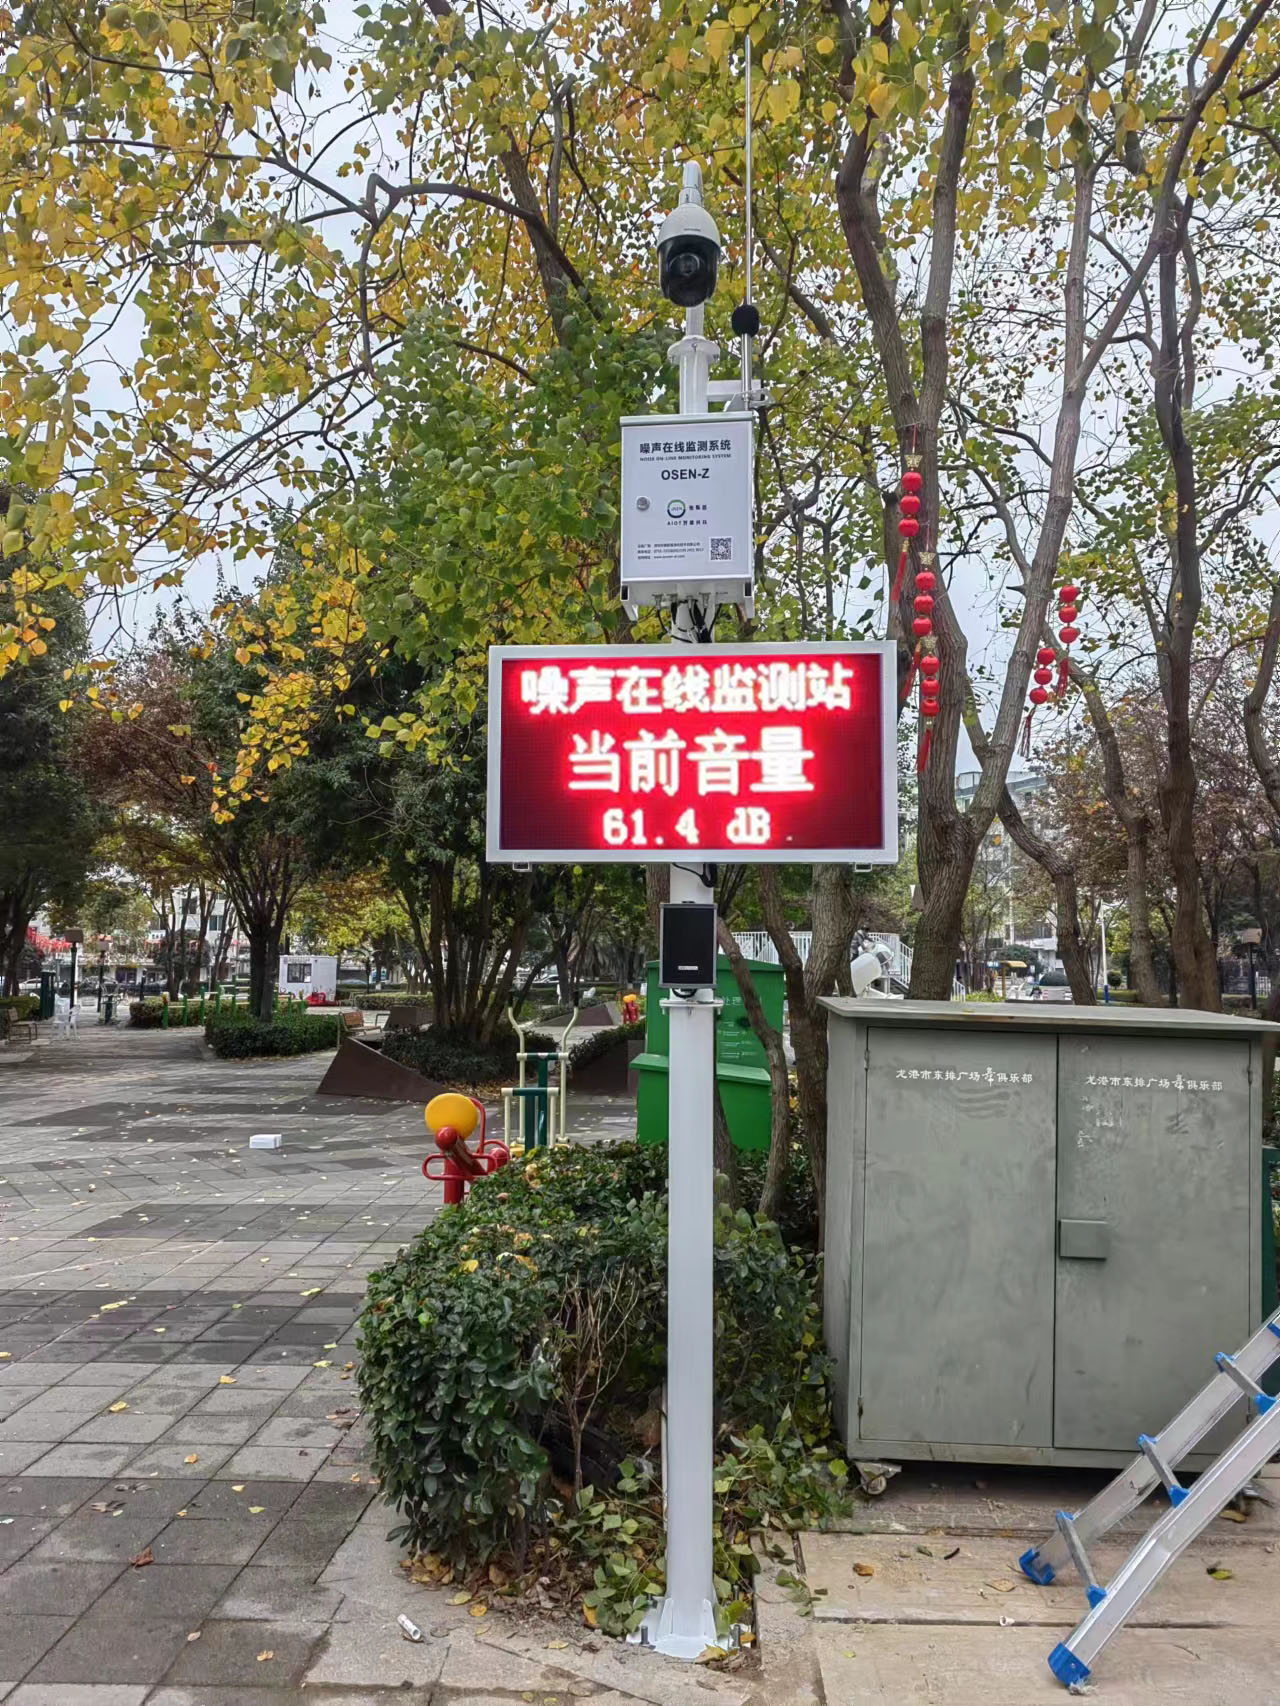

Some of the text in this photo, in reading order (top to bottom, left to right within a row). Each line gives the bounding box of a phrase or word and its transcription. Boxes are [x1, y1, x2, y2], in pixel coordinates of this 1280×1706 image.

[640, 440, 731, 454] 噪声在线监测系统
[661, 468, 710, 480] OSEN-Z
[521, 662, 853, 714] 噪声在线监测站
[568, 726, 815, 796] 当前音量
[602, 806, 771, 845] 61.4 dB
